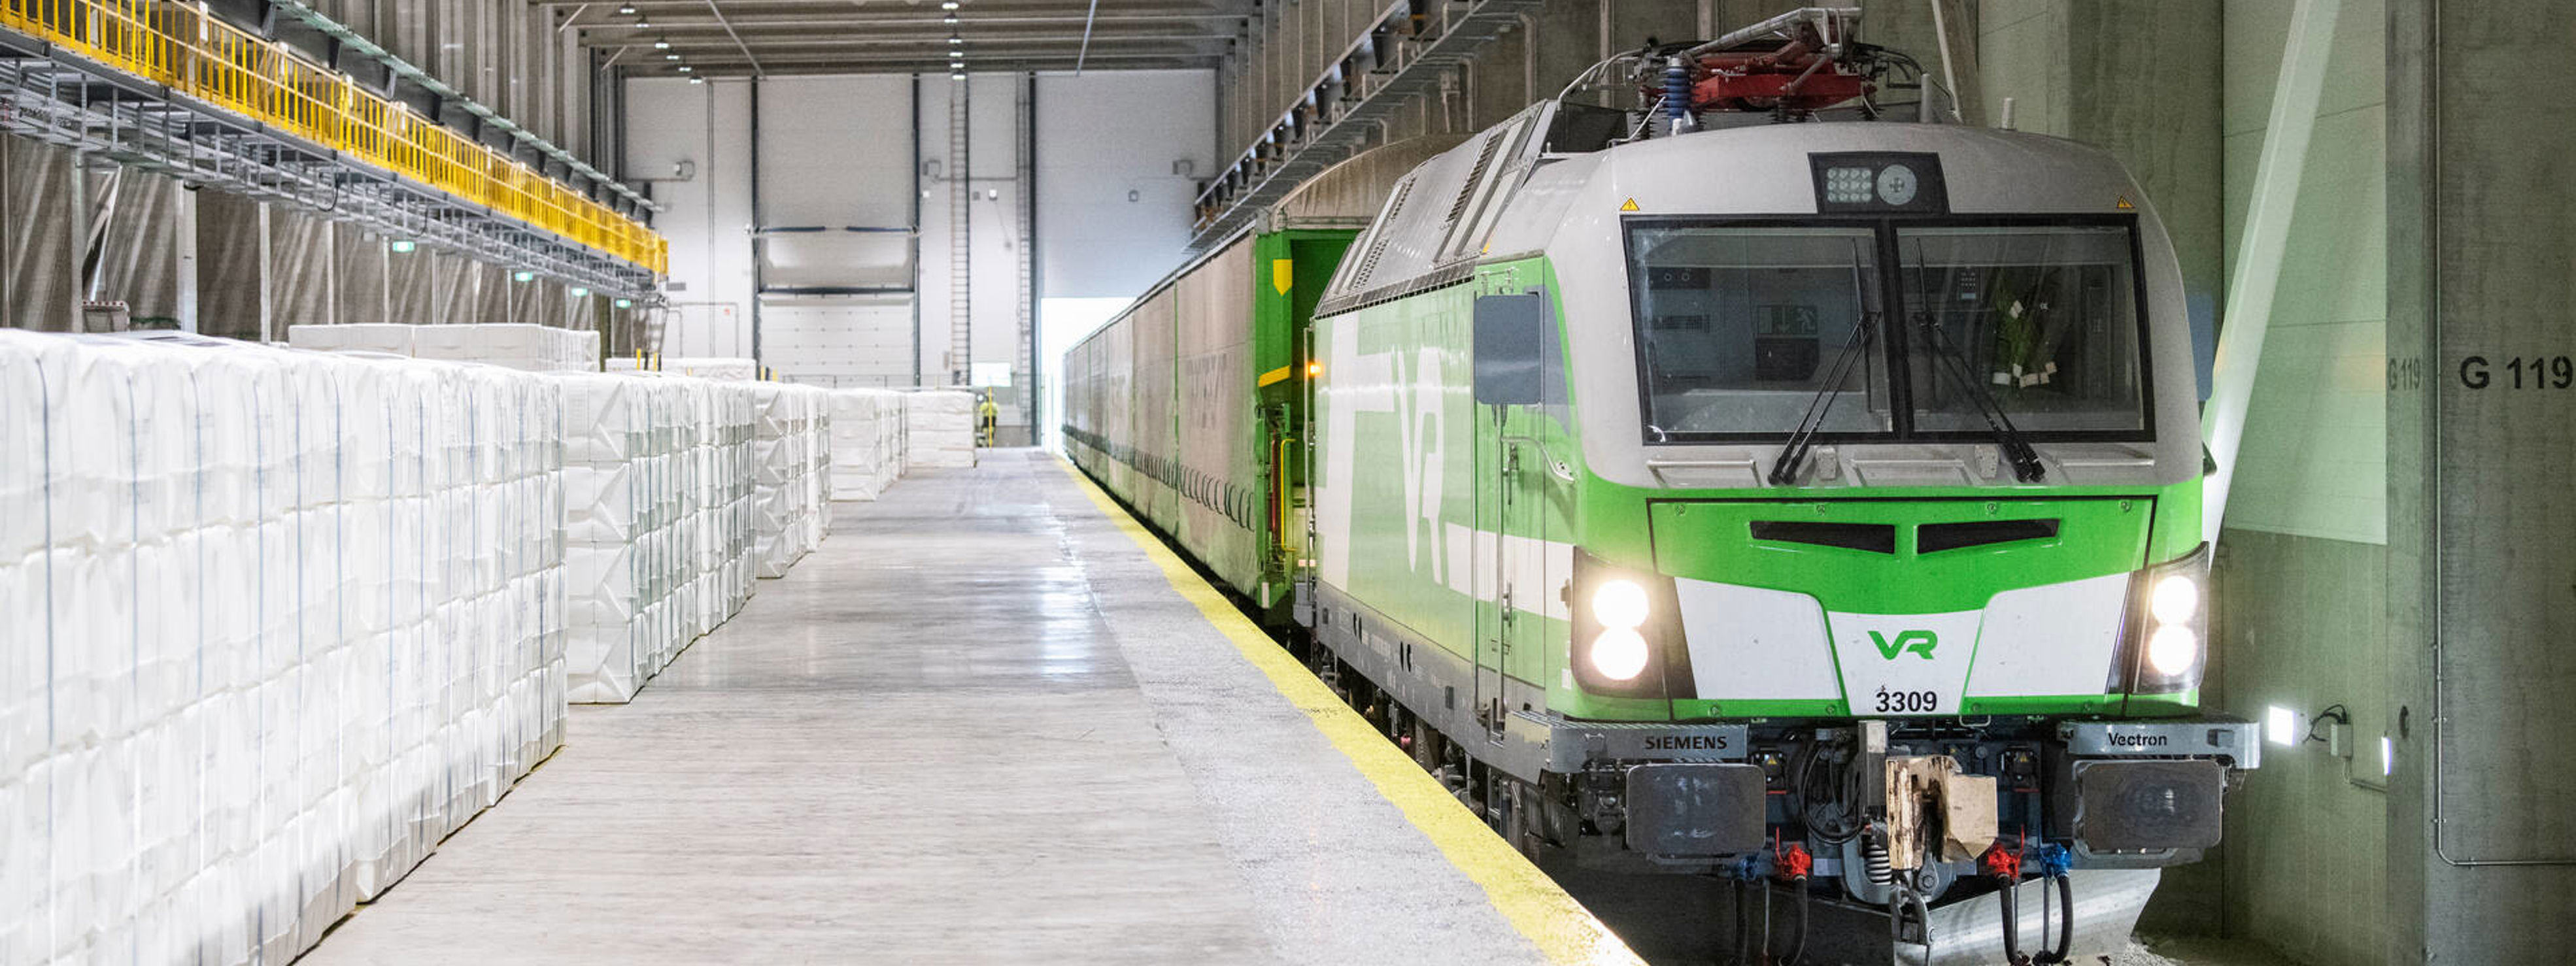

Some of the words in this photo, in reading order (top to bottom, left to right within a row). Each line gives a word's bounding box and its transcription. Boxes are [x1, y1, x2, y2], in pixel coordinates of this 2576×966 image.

[2389, 358, 2398, 391] G
[2401, 358, 2420, 391] 119
[2460, 356, 2490, 389] G
[2506, 356, 2573, 389] 119
[1397, 346, 1444, 585] VR
[1867, 630, 1938, 660] VR
[1875, 691, 1937, 712] 3309
[1644, 736, 1727, 750] SIEMENS
[2108, 732, 2167, 746] Vectron
